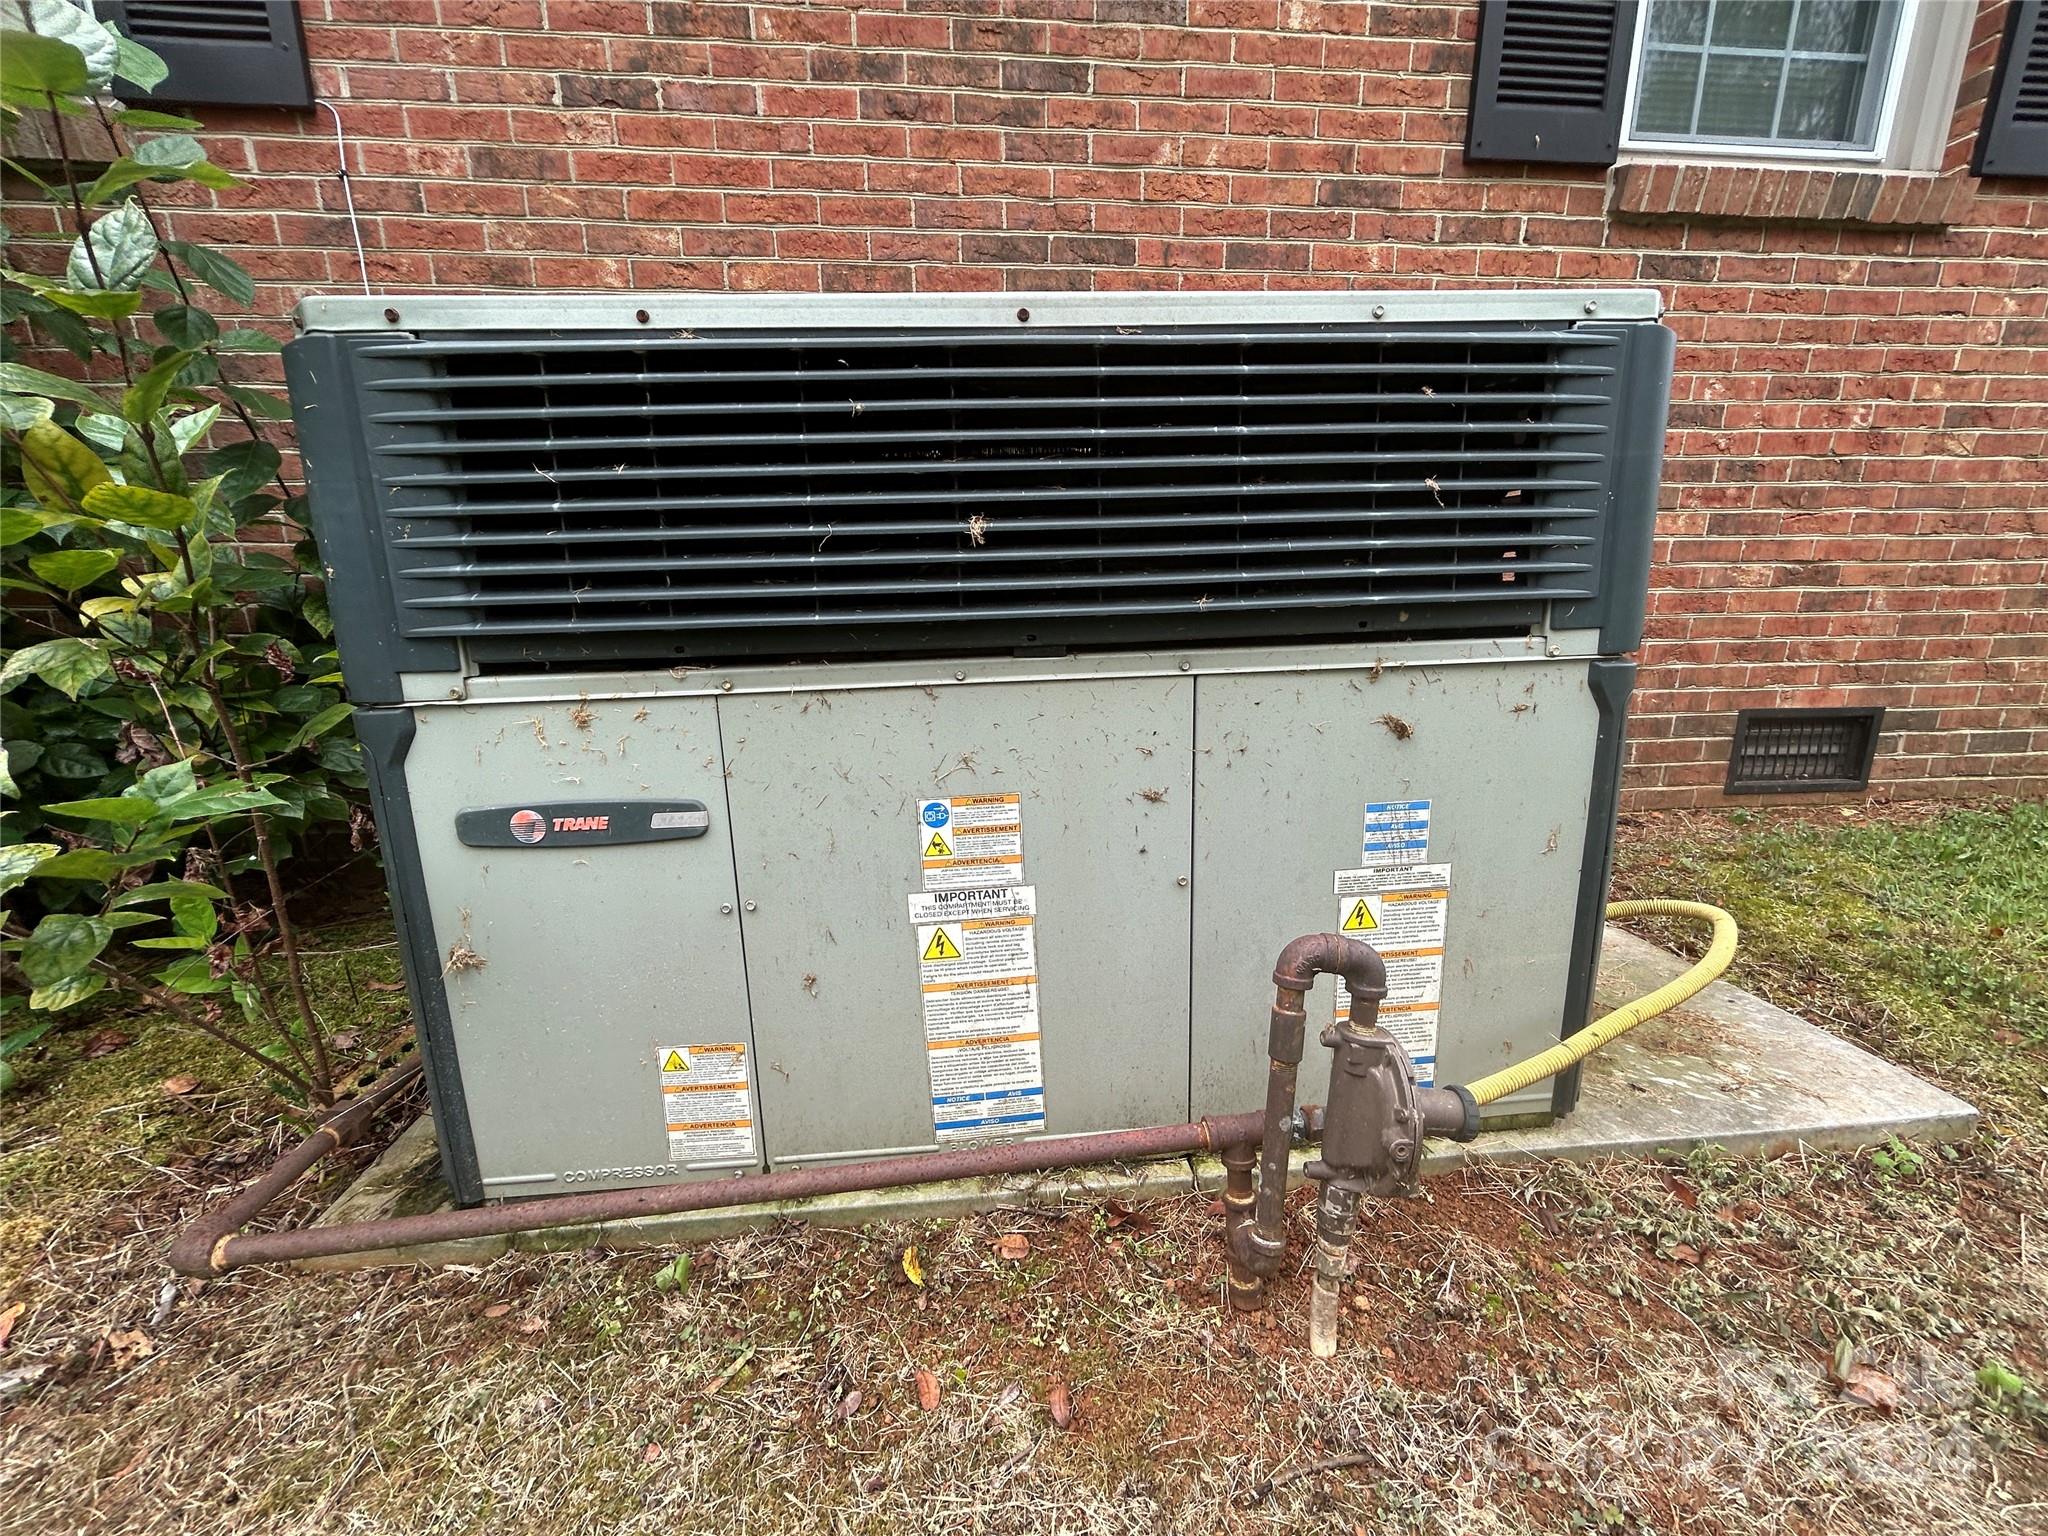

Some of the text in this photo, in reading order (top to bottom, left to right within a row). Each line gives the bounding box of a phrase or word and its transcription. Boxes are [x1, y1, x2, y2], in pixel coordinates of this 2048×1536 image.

[552, 816, 610, 832] TRANE
[1373, 866, 1414, 874] IMPORTANT
[934, 888, 1007, 902] IMPORTANT
[938, 901, 991, 909] COMPARTMENT
[956, 979, 1008, 988] AVERTISSEMENT
[965, 1035, 1009, 1045] ADVERTENCIA
[950, 1137, 1014, 1152] BLOWER
[563, 1164, 679, 1183] COMPRESSOR
